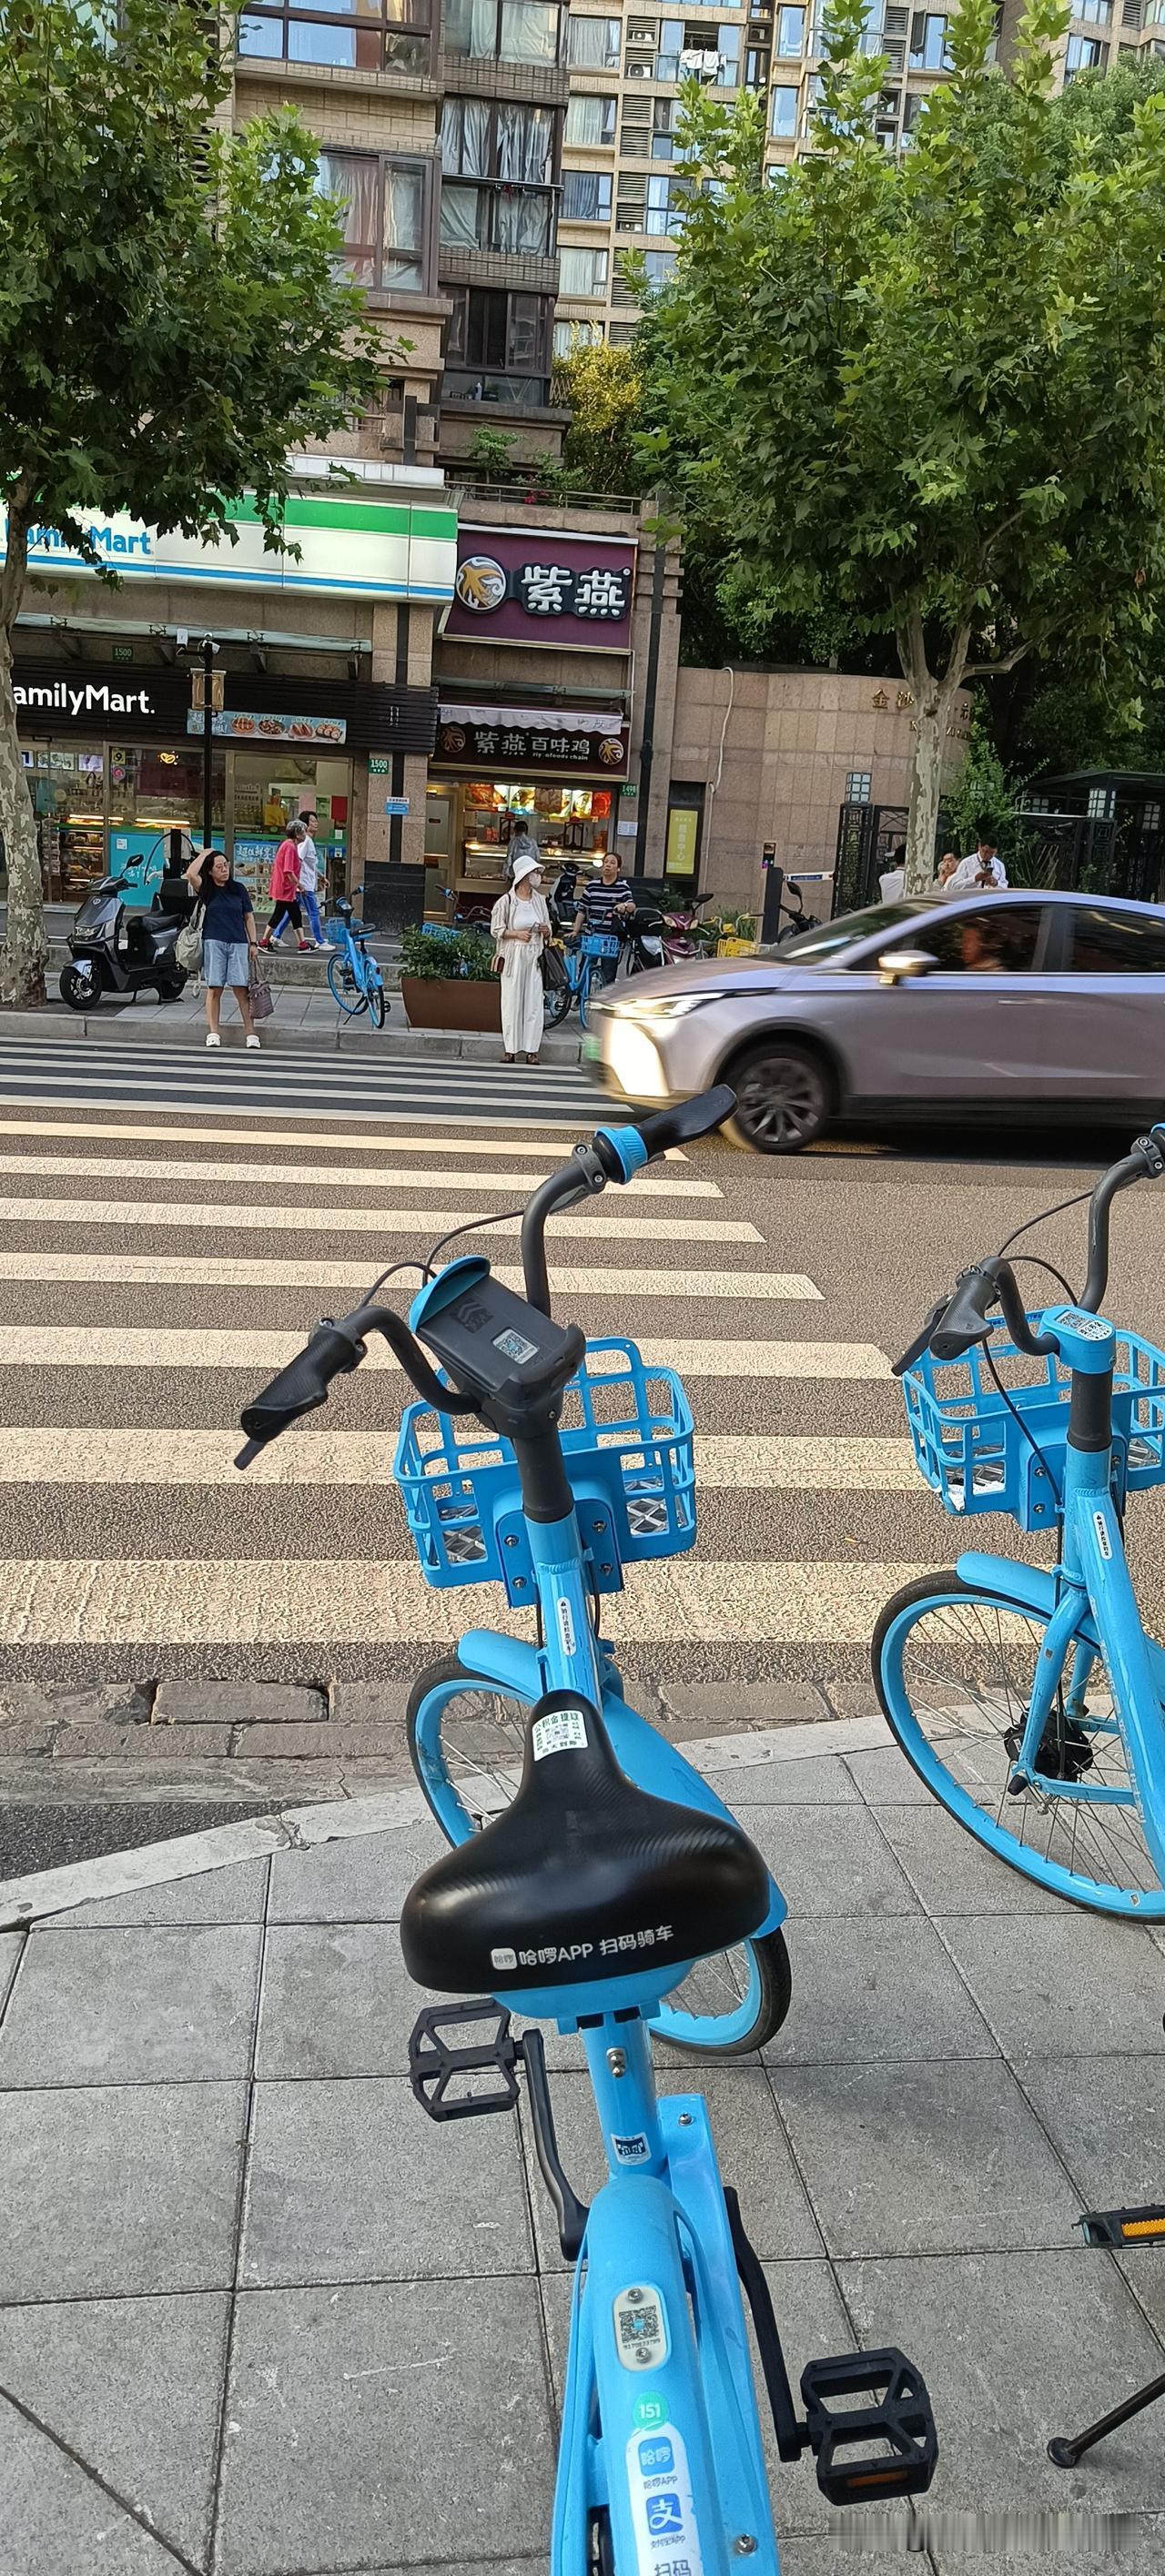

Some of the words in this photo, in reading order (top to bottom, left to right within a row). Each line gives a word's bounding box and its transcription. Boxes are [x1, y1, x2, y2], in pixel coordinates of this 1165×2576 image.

[521, 565, 625, 616] 紫燕
[115, 647, 132, 657] 1500
[10, 679, 155, 715] amilyMart.
[473, 731, 590, 756] 紫燕百味鸡
[370, 759, 388, 769] 1500
[599, 1924, 675, 1956] 扫码骑车
[639, 2403, 662, 2419] 151
